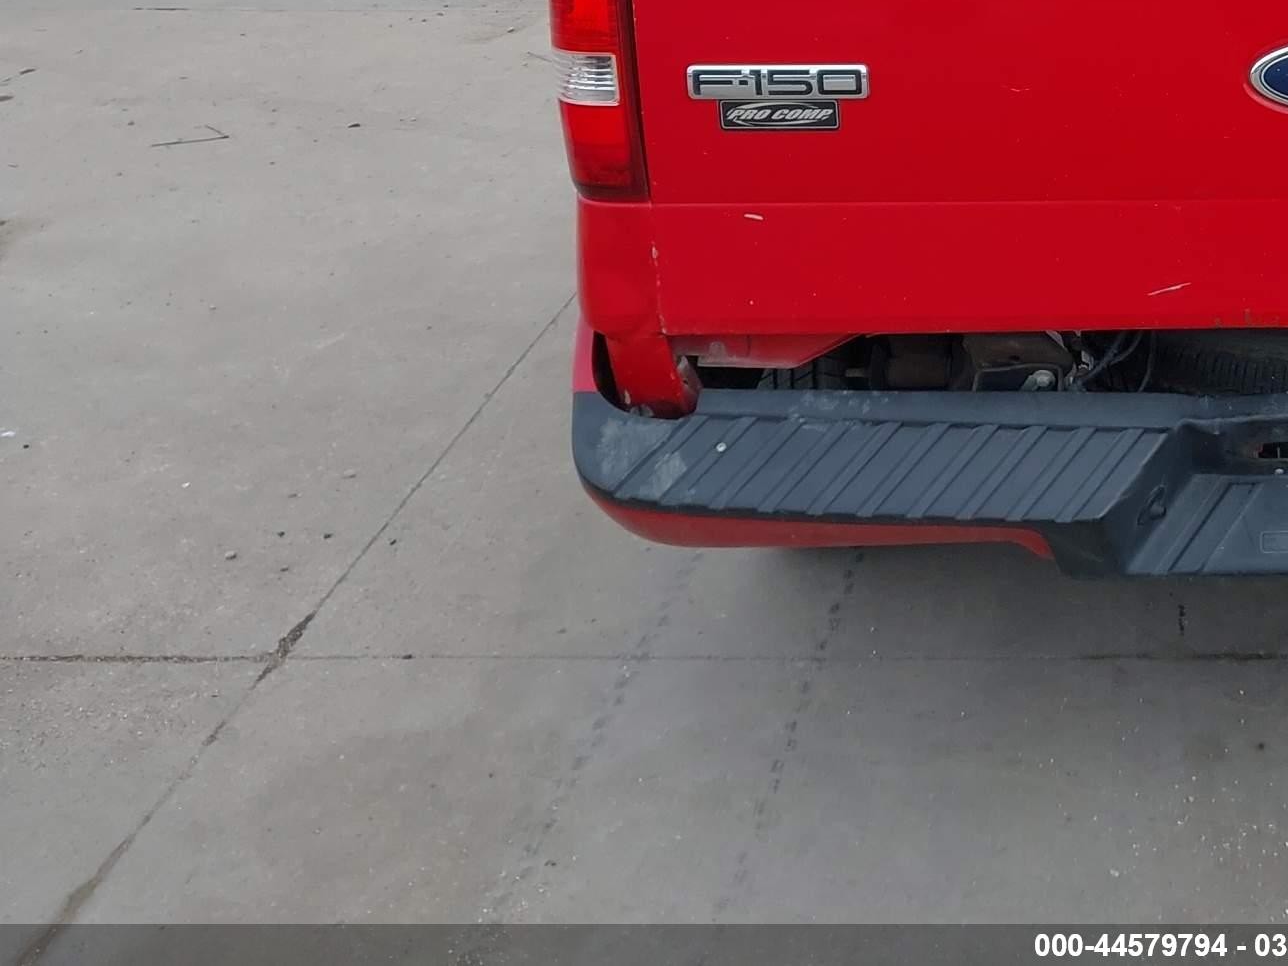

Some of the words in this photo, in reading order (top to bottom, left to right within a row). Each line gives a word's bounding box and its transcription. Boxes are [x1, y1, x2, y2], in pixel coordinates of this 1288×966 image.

[692, 69, 863, 96] F-150
[728, 108, 770, 121] PRO
[771, 108, 834, 121] COMP
